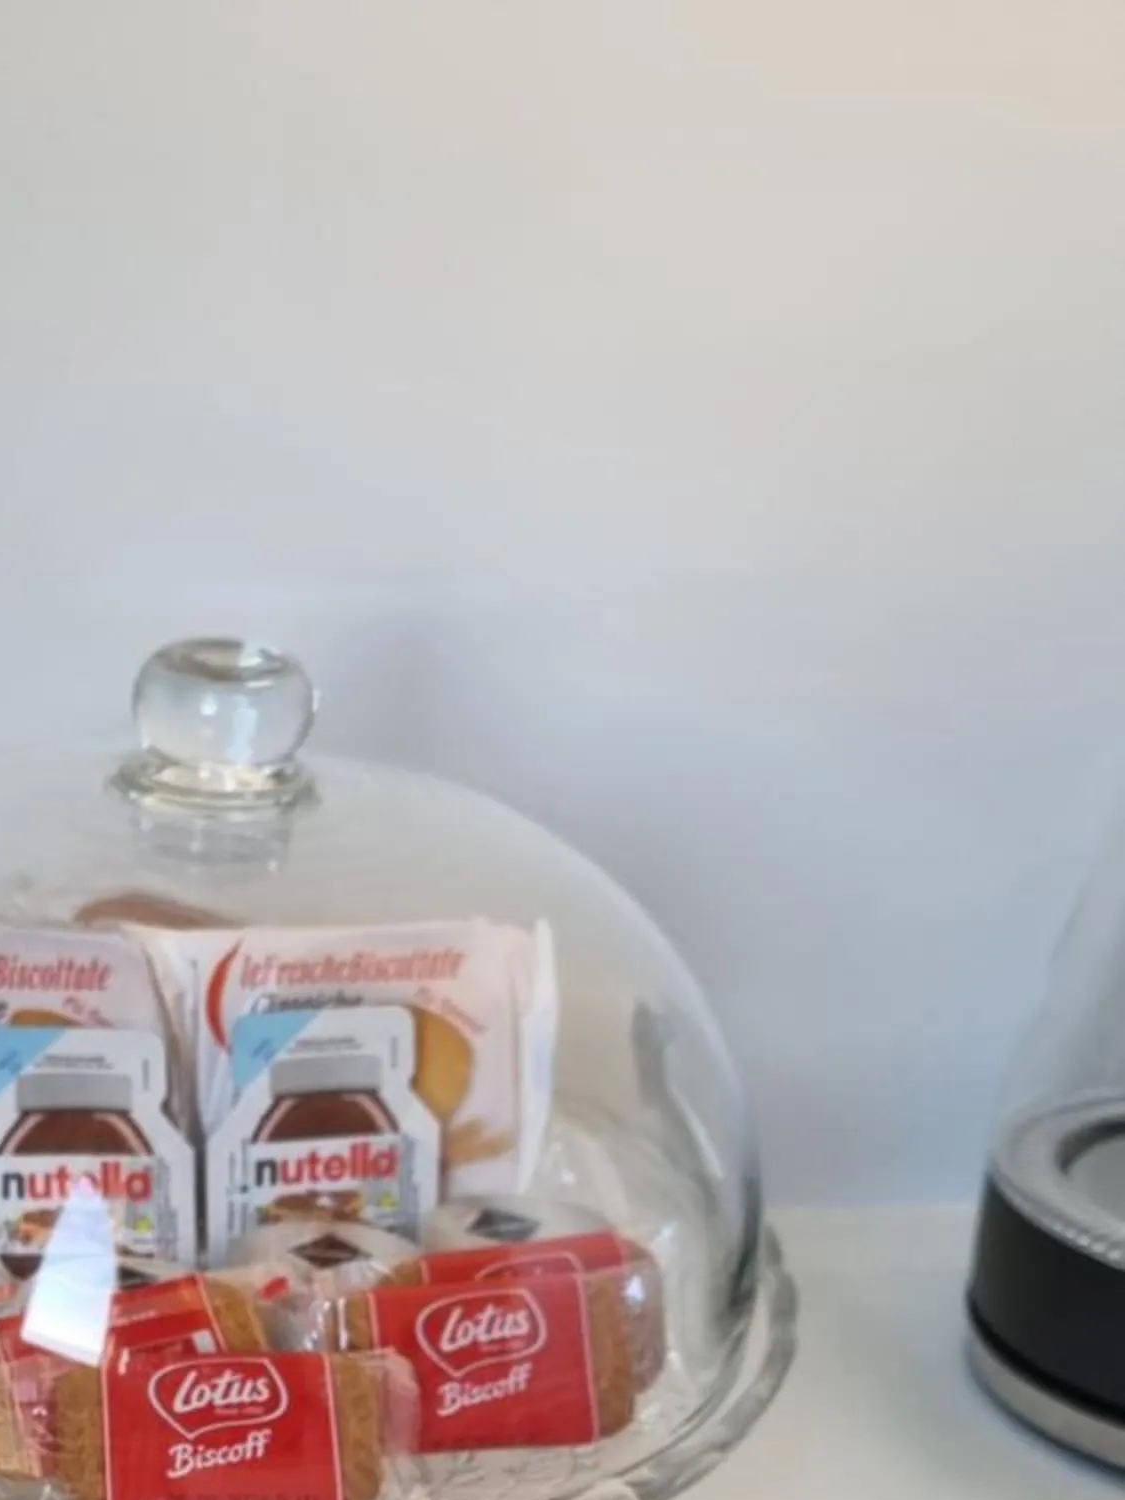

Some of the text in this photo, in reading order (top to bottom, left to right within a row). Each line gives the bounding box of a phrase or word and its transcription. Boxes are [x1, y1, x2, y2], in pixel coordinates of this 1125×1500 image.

[255, 1141, 398, 1187] nutella
[439, 1305, 530, 1352] Lotus
[174, 1368, 271, 1413] Lotus
[437, 1362, 531, 1418] Biscoff
[166, 1429, 272, 1479] Biscoff
